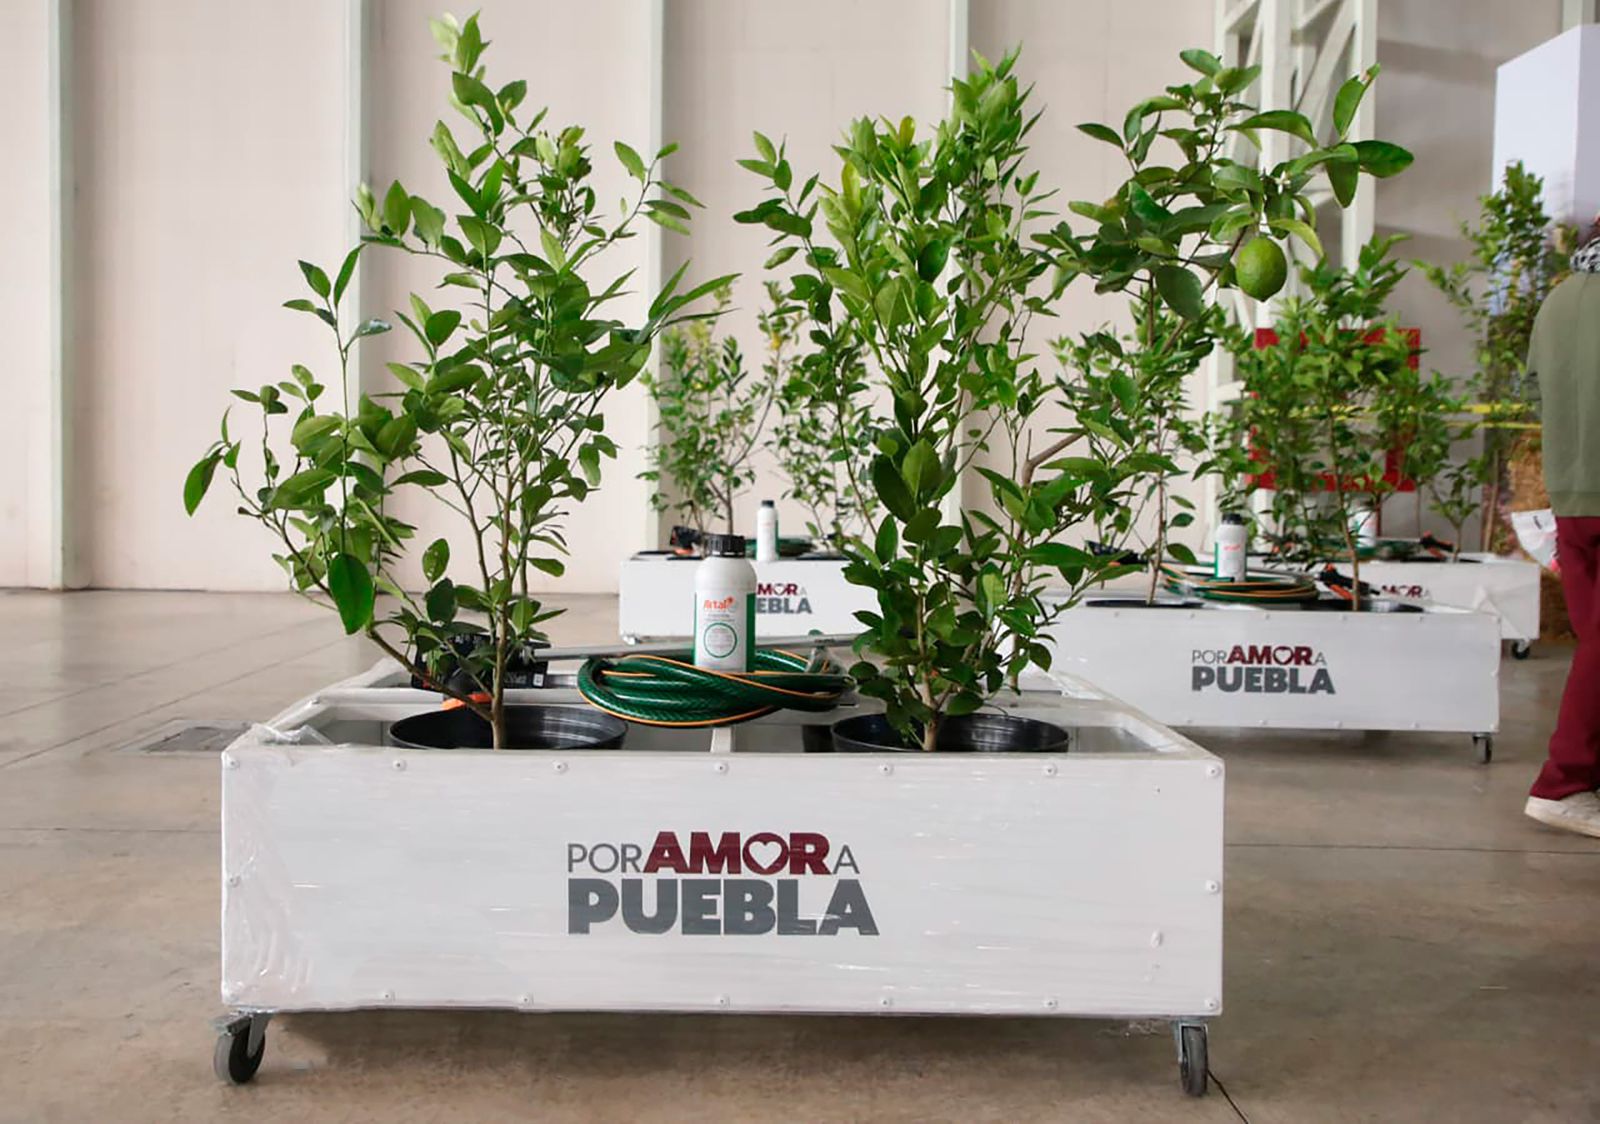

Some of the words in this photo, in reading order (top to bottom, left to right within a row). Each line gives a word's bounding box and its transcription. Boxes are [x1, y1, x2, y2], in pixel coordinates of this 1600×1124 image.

[756, 583, 798, 596] MOR
[757, 598, 812, 614] EBLA
[1192, 649, 1226, 664] POR
[1226, 645, 1313, 665] AMOR
[1314, 652, 1327, 665] A
[1192, 666, 1336, 694] PUEBLA
[568, 843, 642, 873] POR
[643, 831, 832, 875] AMOR
[832, 844, 860, 874] A
[568, 878, 880, 935] PUEBLA
